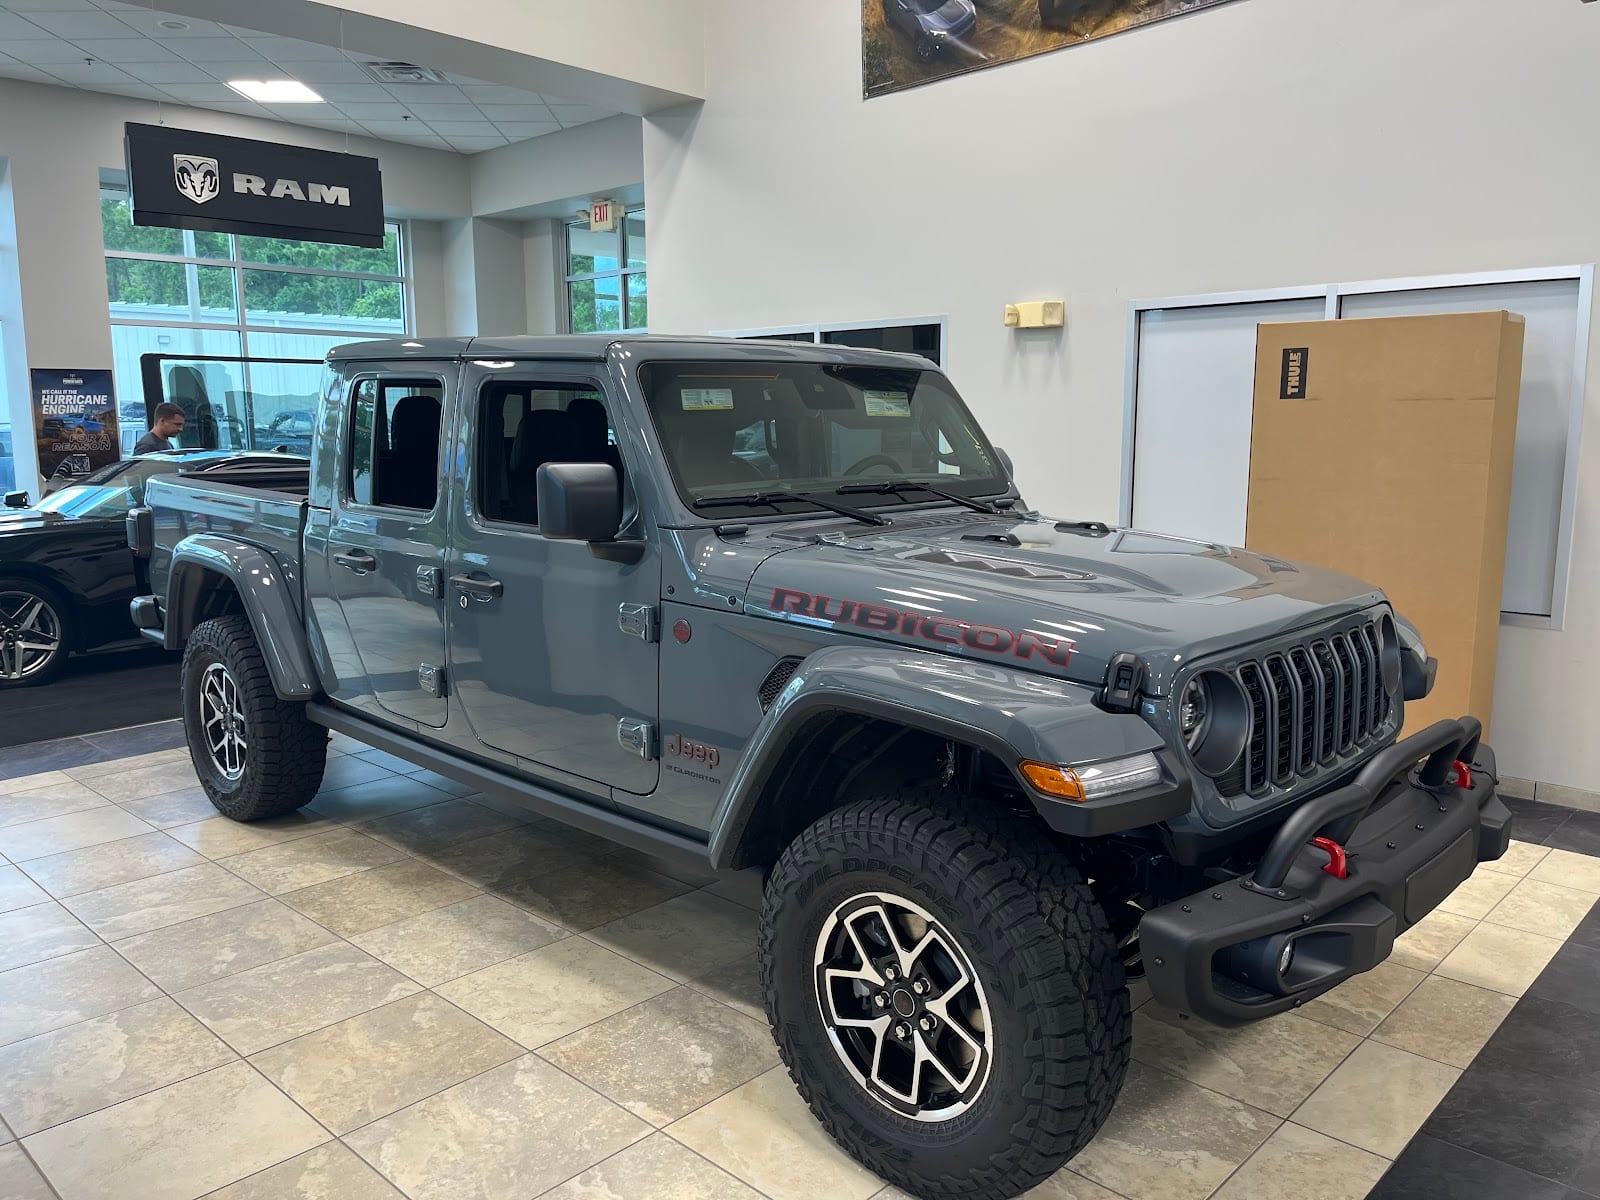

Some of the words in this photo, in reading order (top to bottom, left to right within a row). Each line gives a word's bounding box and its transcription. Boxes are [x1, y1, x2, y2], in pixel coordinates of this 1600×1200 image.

[232, 172, 351, 207] RAM
[594, 203, 609, 223] EXIT
[1287, 352, 1302, 395] THULE
[41, 395, 108, 405] HURRICANE
[42, 405, 86, 415] ENGINE
[52, 442, 111, 451] REASON
[69, 434, 97, 443] FOR
[100, 434, 111, 443] A
[769, 587, 1077, 669] RUBICON
[667, 733, 721, 769] Jeep
[673, 766, 721, 785] GLADIATOR
